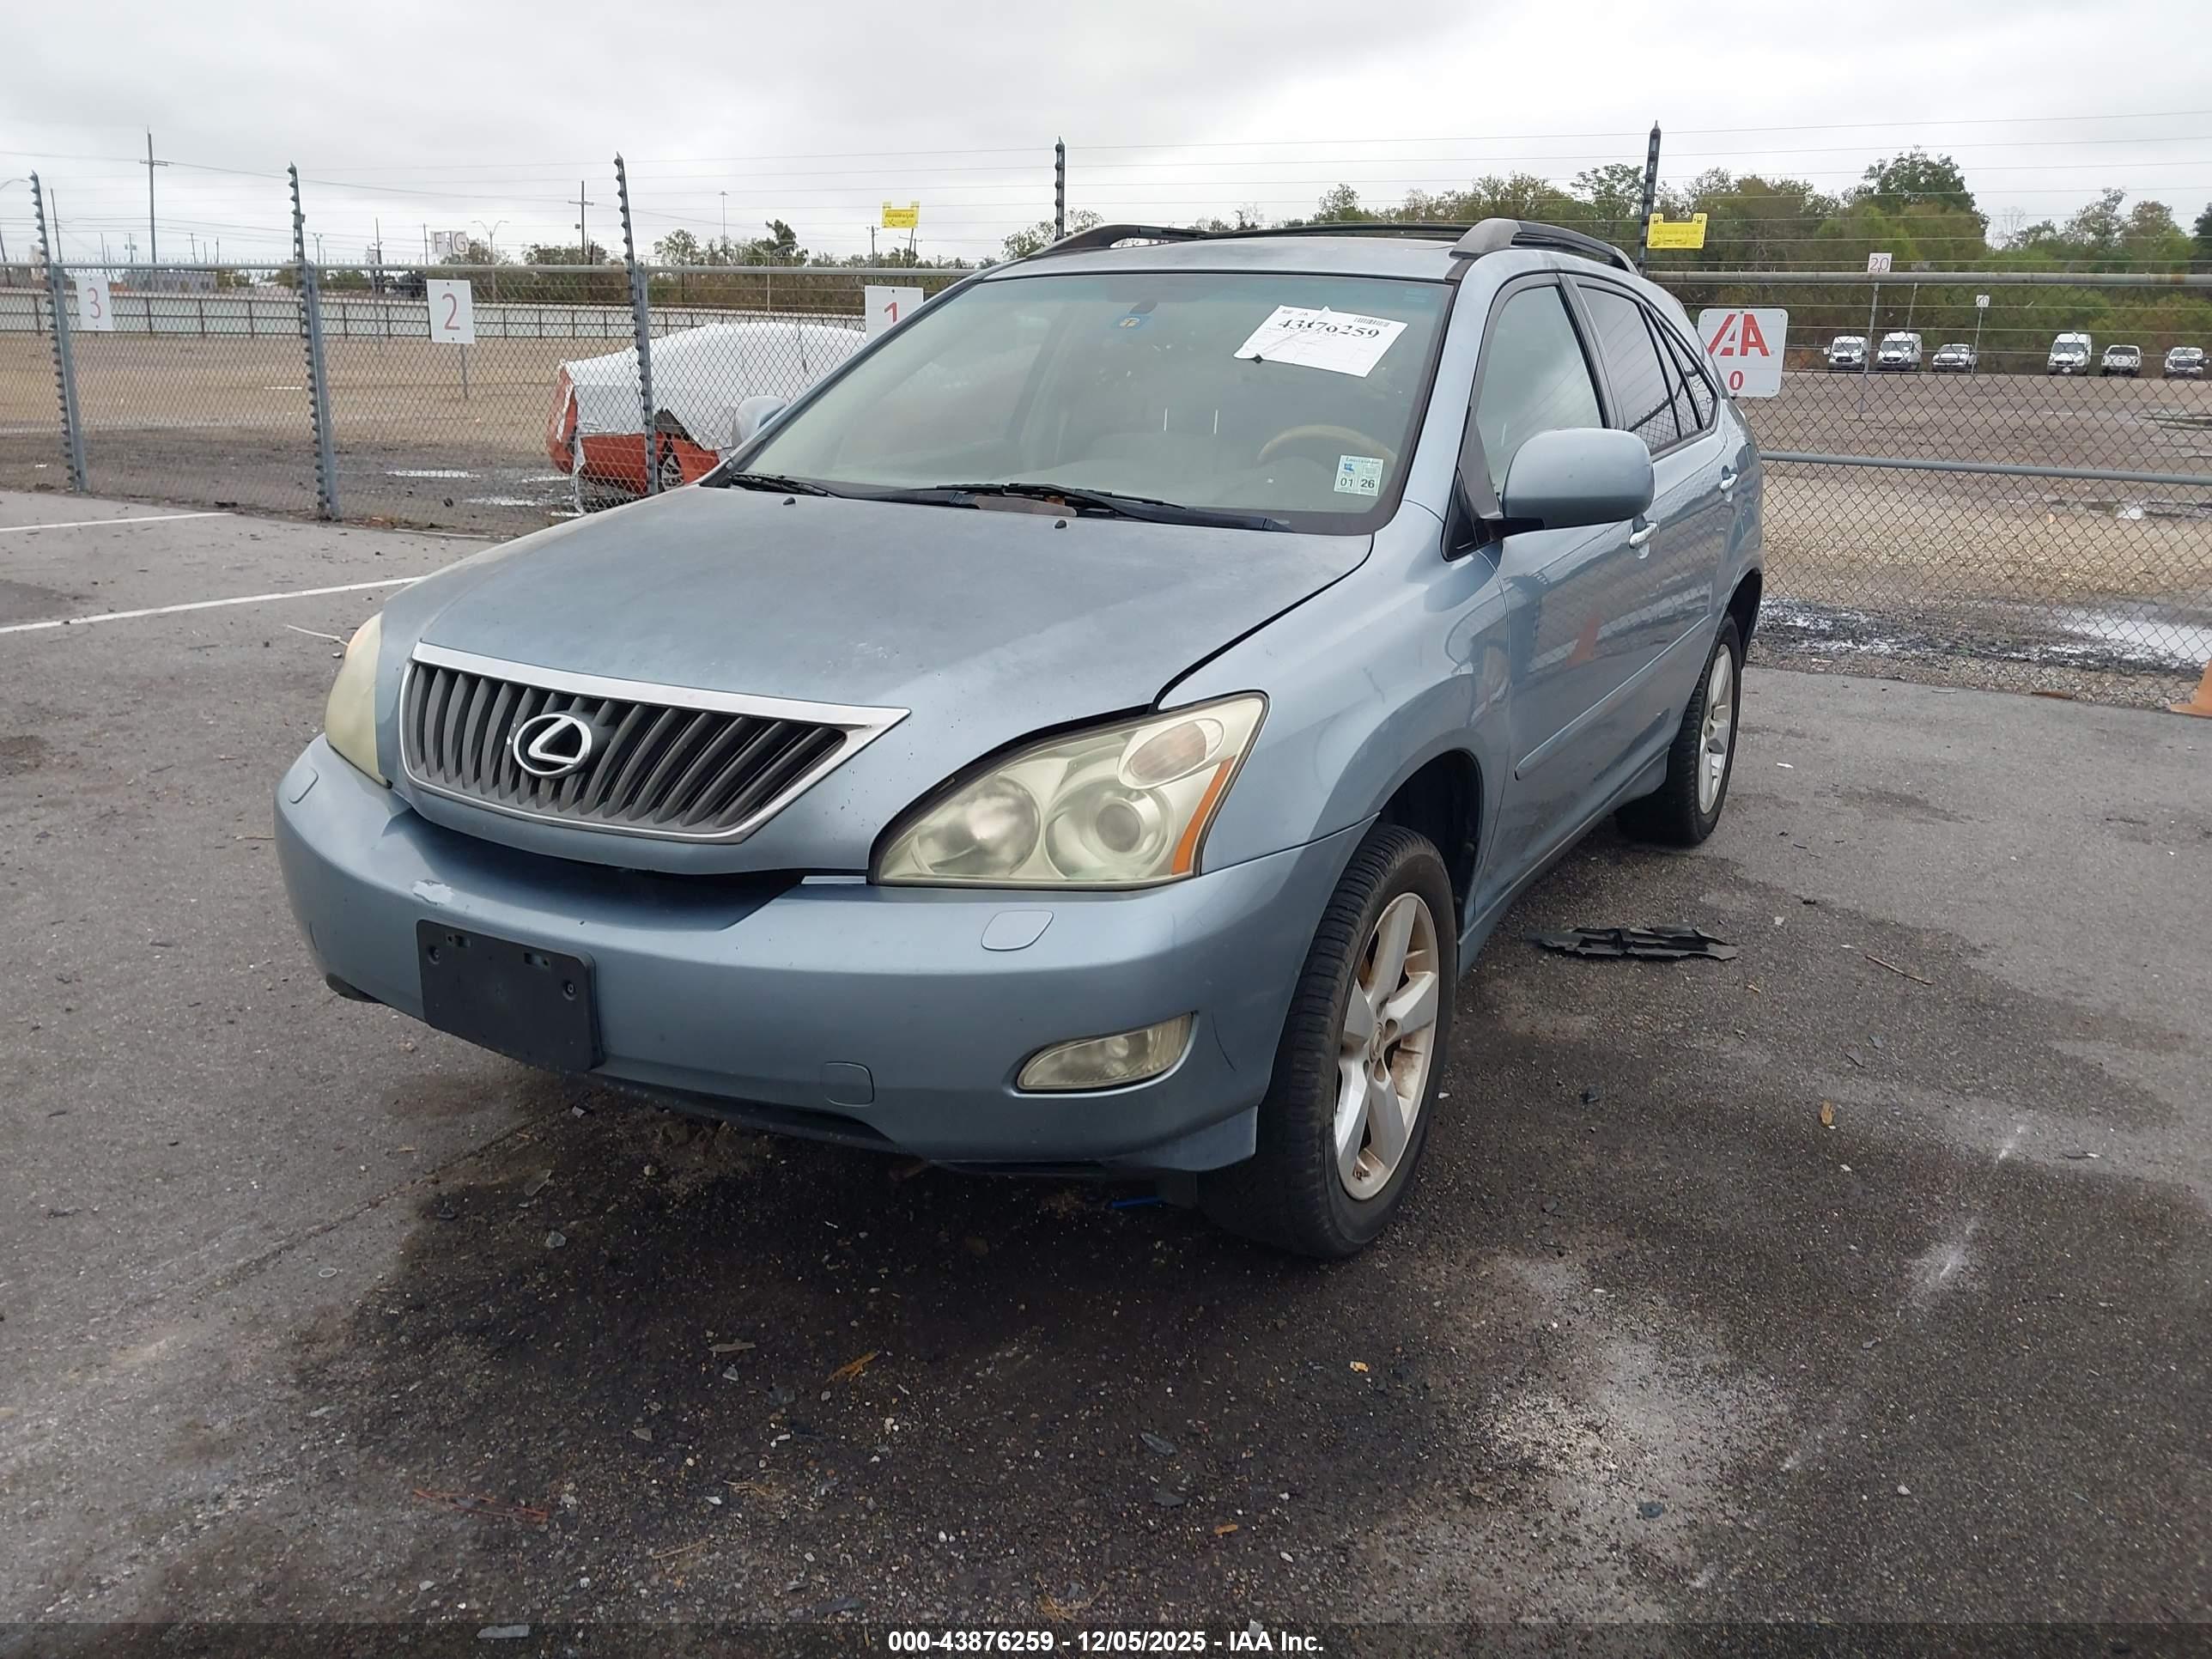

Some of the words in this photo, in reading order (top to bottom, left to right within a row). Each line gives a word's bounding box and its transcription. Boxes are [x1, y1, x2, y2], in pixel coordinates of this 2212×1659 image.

[434, 232, 442, 253] F
[453, 232, 466, 252] G
[1869, 257, 1890, 270] 20
[87, 287, 101, 319] 3
[441, 292, 461, 331] 2
[884, 301, 897, 324] 1
[1729, 370, 1744, 391] 0
[1340, 477, 1353, 488] 01
[1360, 478, 1375, 489] 26
